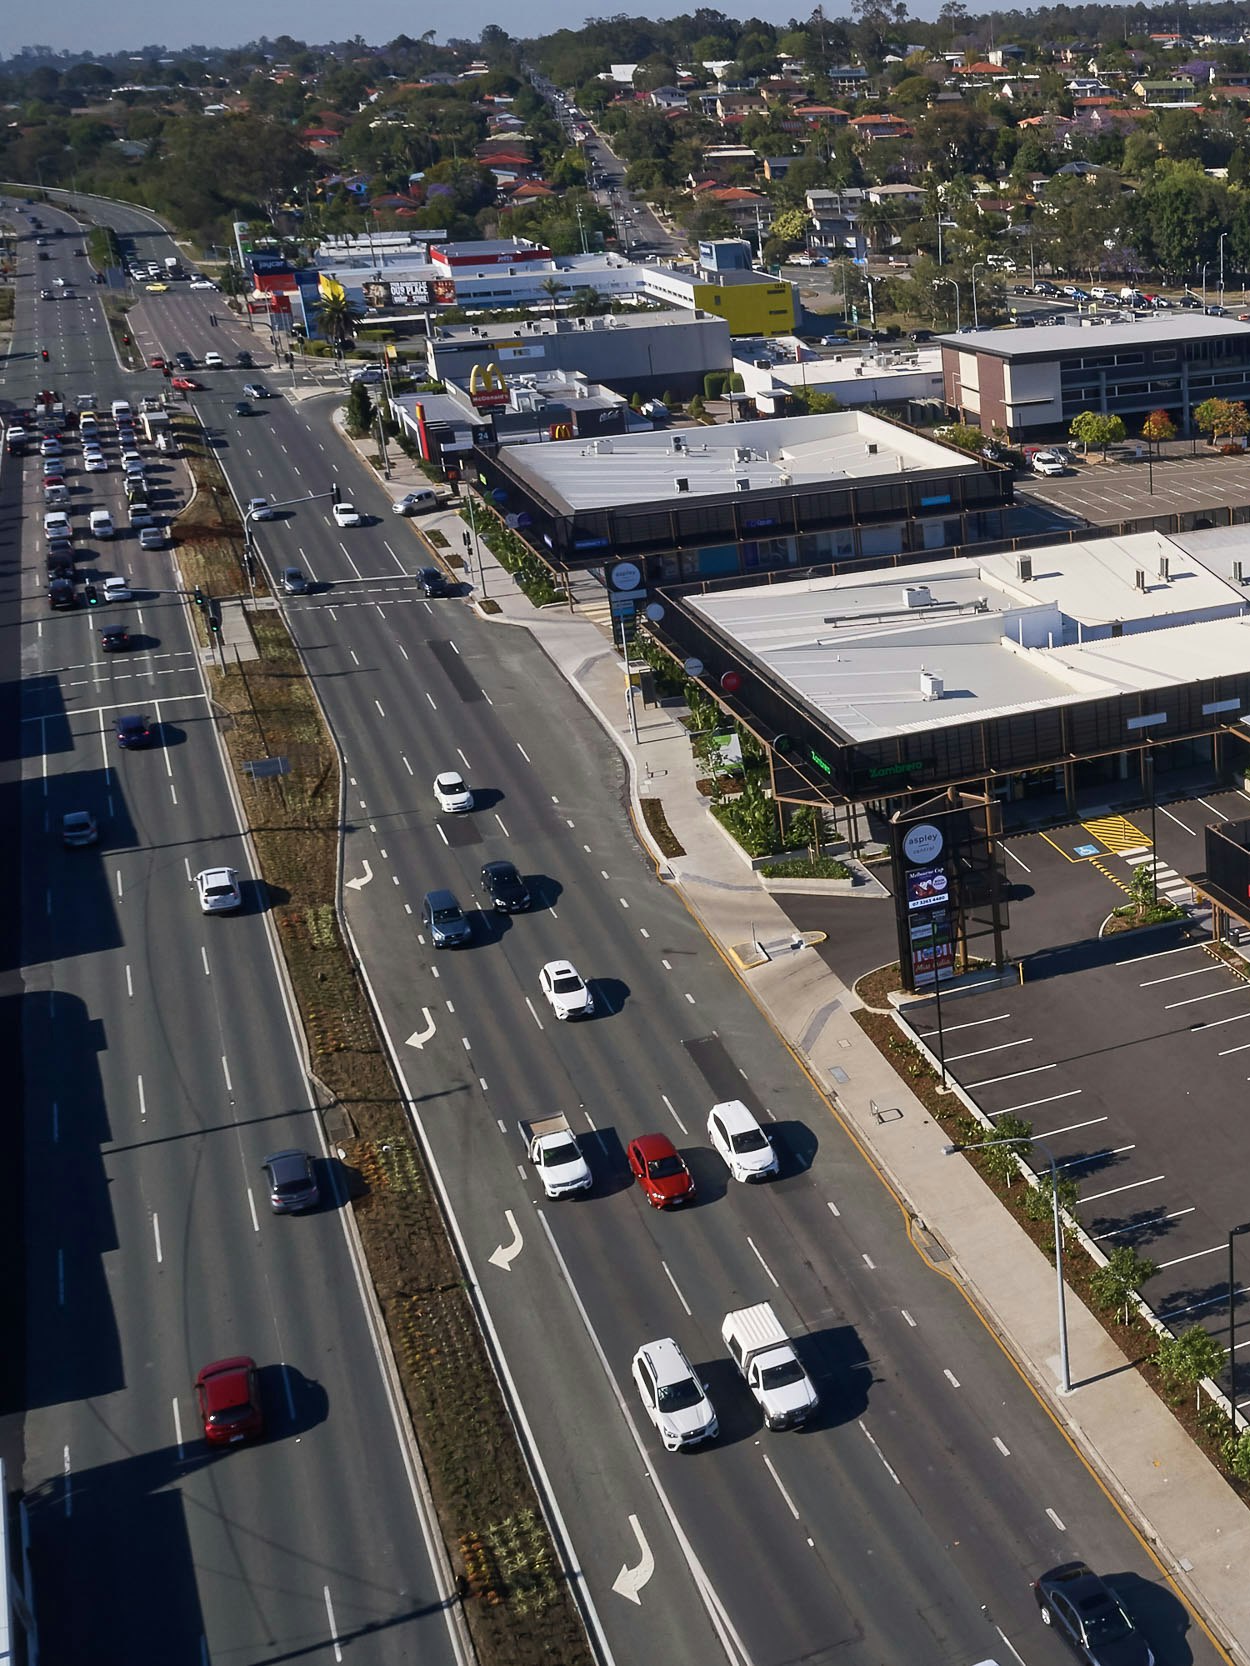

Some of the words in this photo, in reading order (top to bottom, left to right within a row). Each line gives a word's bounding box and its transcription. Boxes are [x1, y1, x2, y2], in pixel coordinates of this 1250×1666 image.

[390, 286, 406, 296] OUR
[406, 285, 429, 296] PLACE
[473, 394, 508, 402] McDonald's
[478, 432, 489, 441] 24
[870, 762, 922, 778] Zambrero
[908, 833, 938, 845] aspley
[934, 867, 944, 875] Cup
